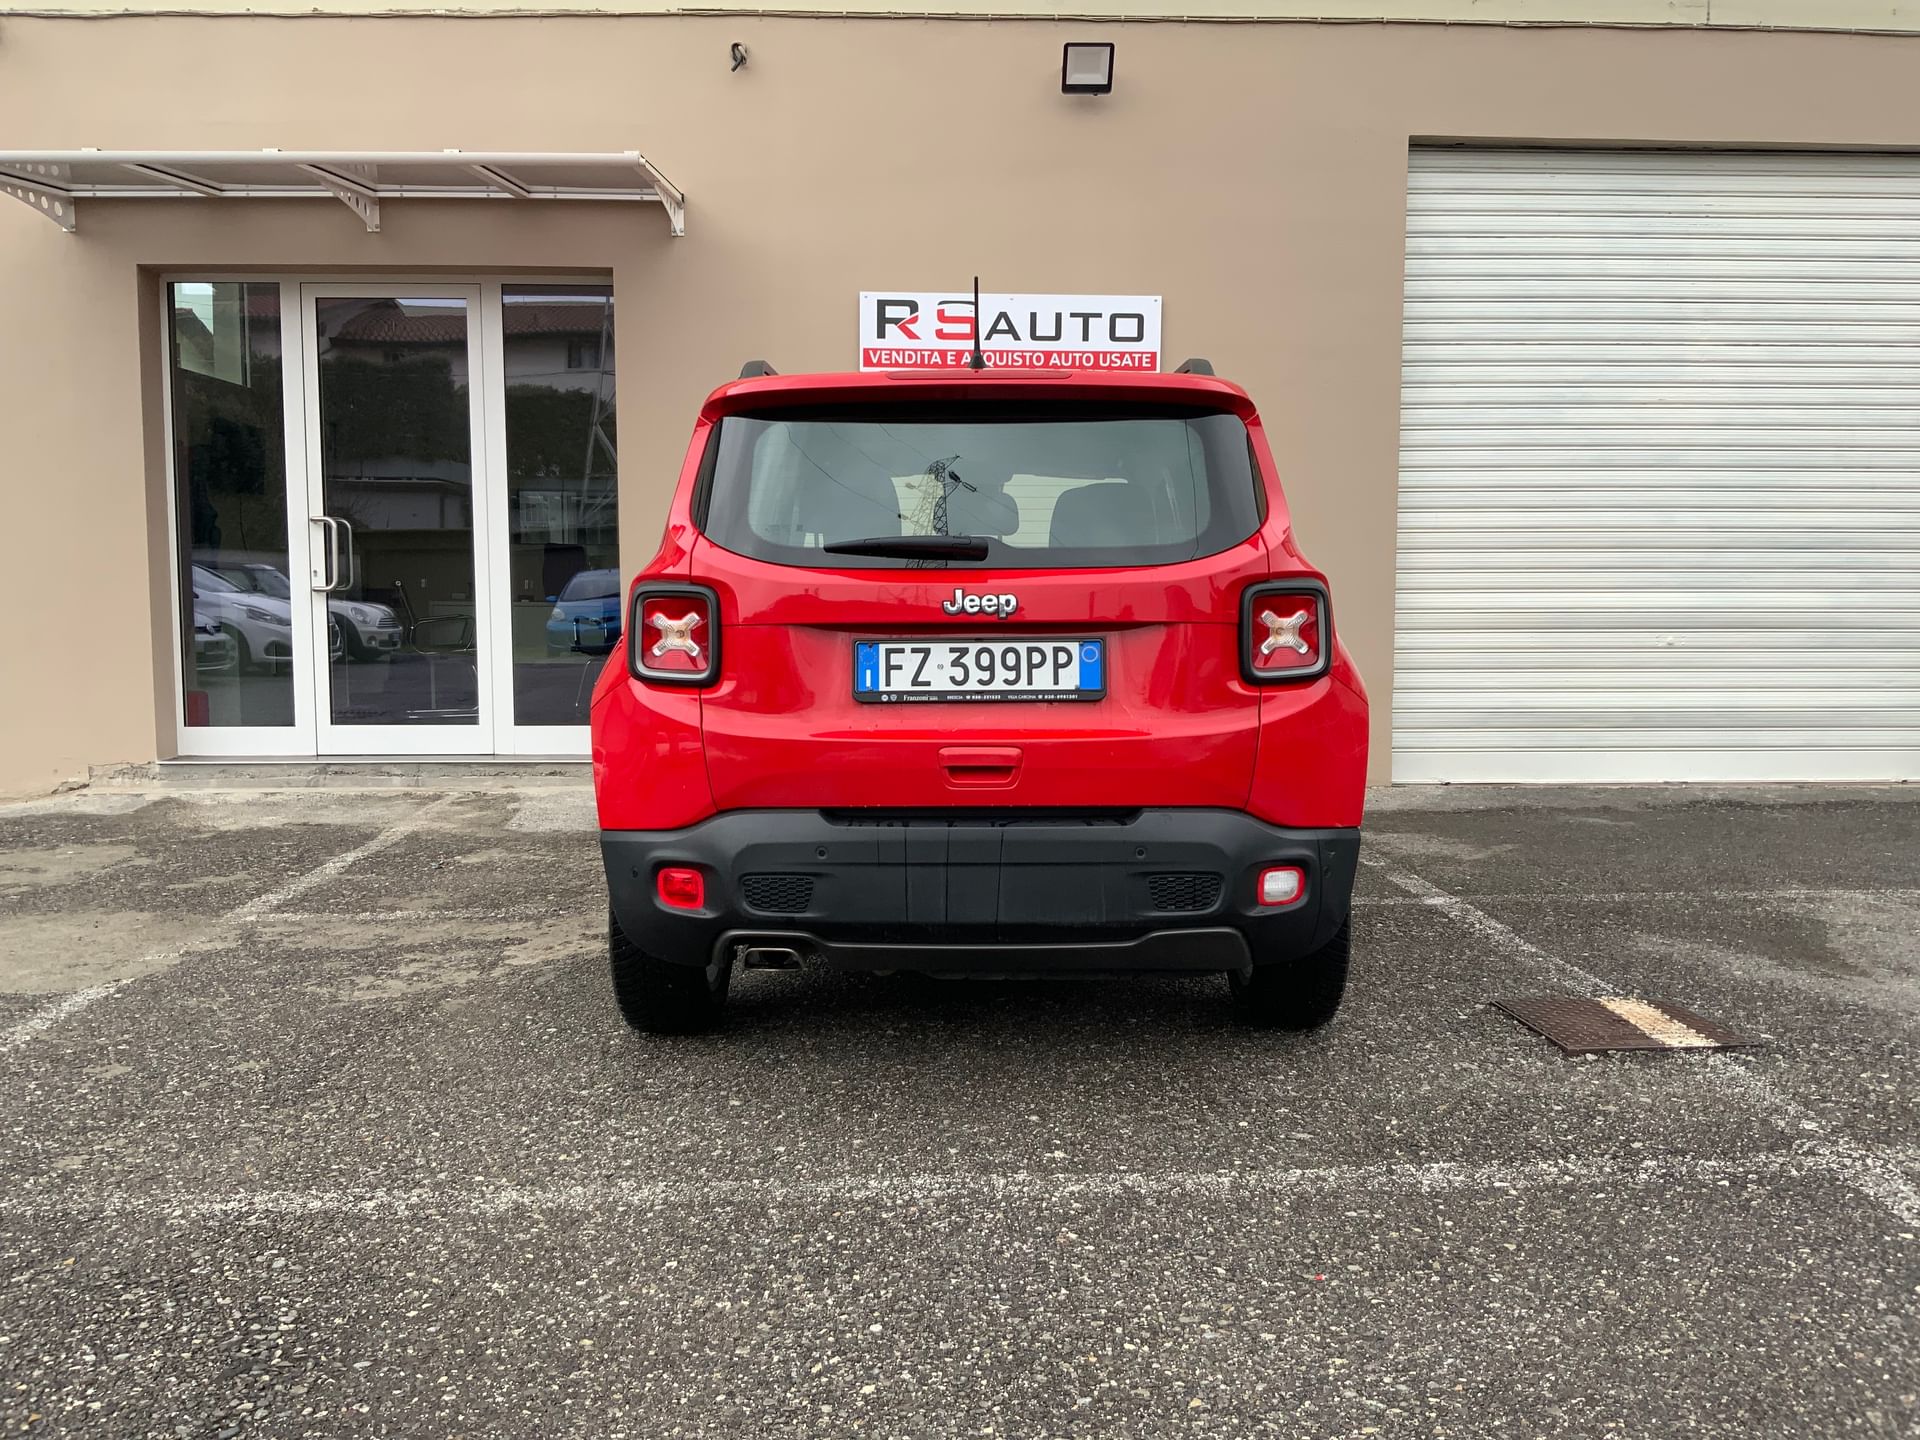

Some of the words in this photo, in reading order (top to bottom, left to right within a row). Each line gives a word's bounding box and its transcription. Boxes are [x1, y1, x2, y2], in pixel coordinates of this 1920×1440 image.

[868, 350, 942, 365] VENDITA
[946, 351, 957, 365] E
[960, 352, 1045, 367] AQUISTO
[1048, 352, 1095, 367] AUTO
[1099, 353, 1152, 367] USATE
[942, 588, 1018, 619] Jeep
